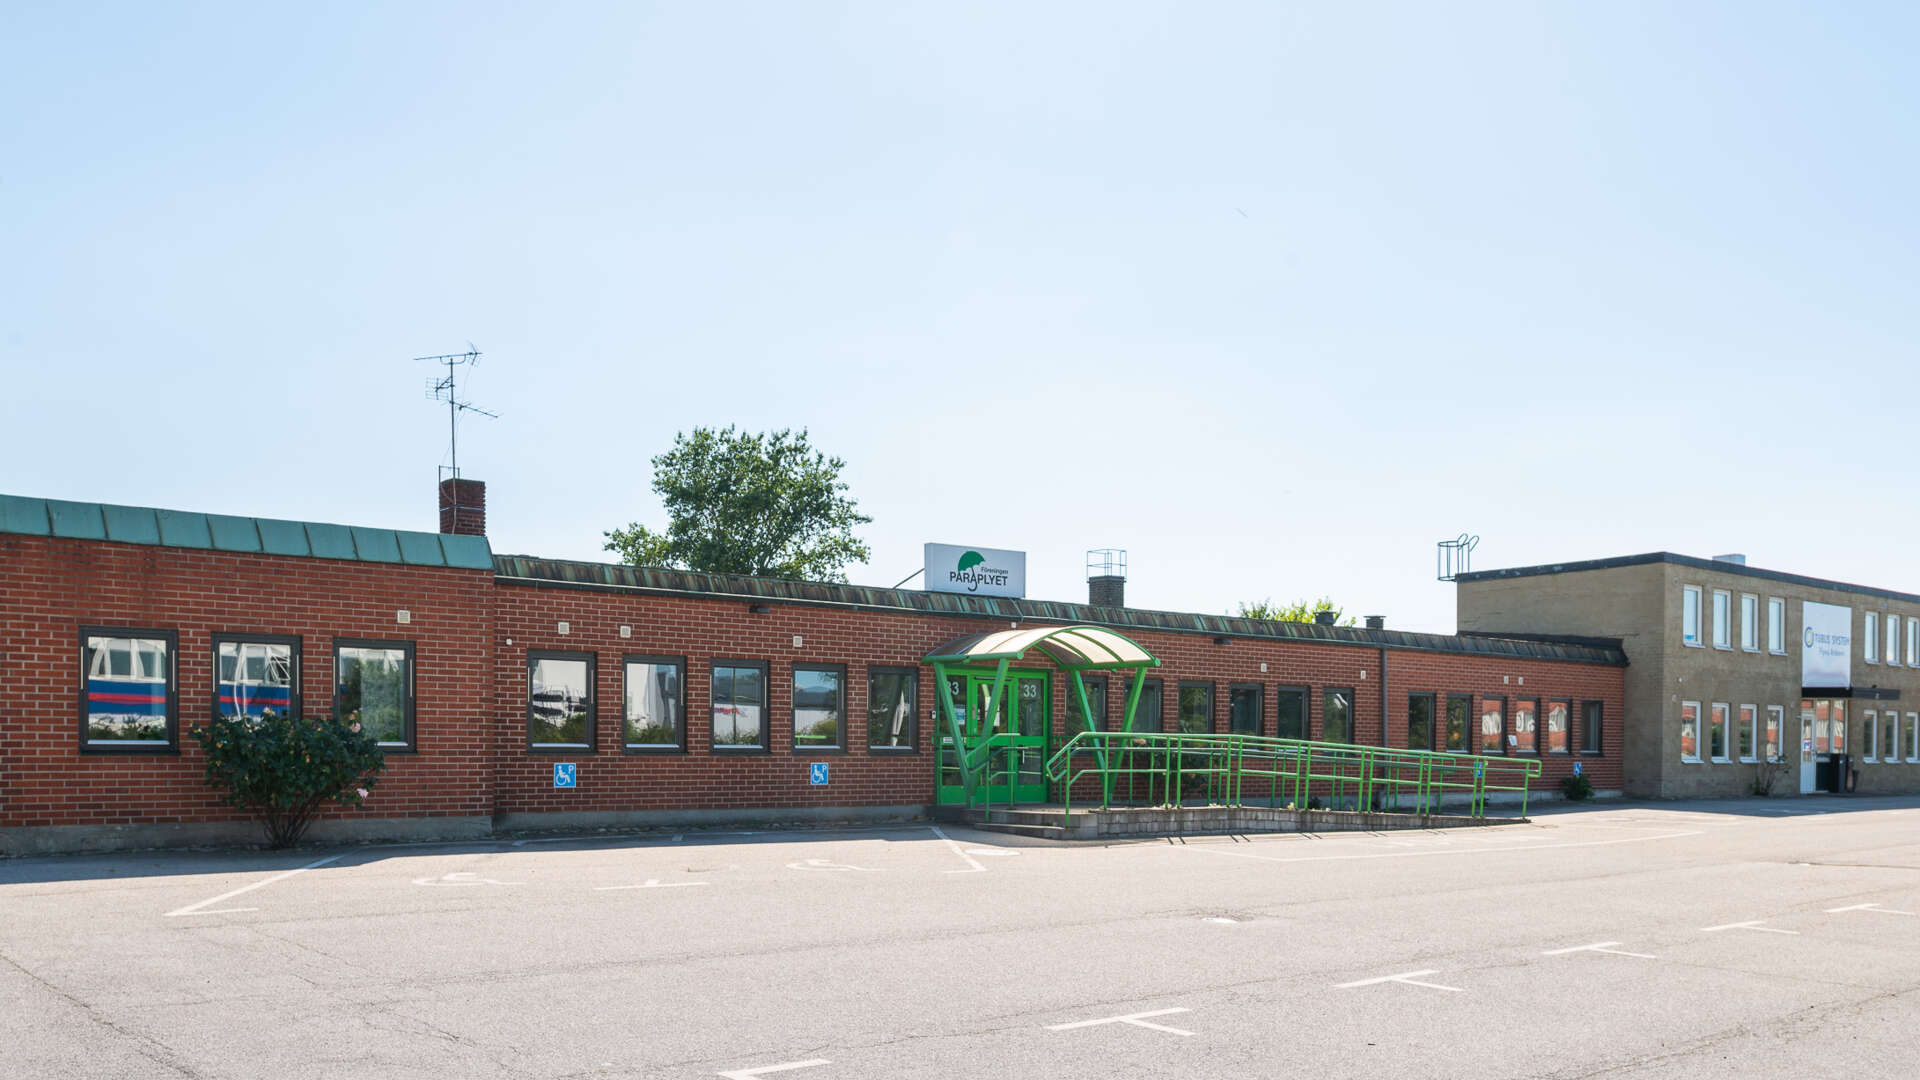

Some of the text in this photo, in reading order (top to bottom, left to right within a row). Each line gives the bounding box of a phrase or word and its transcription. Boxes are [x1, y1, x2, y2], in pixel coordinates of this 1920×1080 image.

[949, 571, 1008, 587] PARAPLYET
[1023, 684, 1037, 698] 33
[568, 765, 575, 774] P
